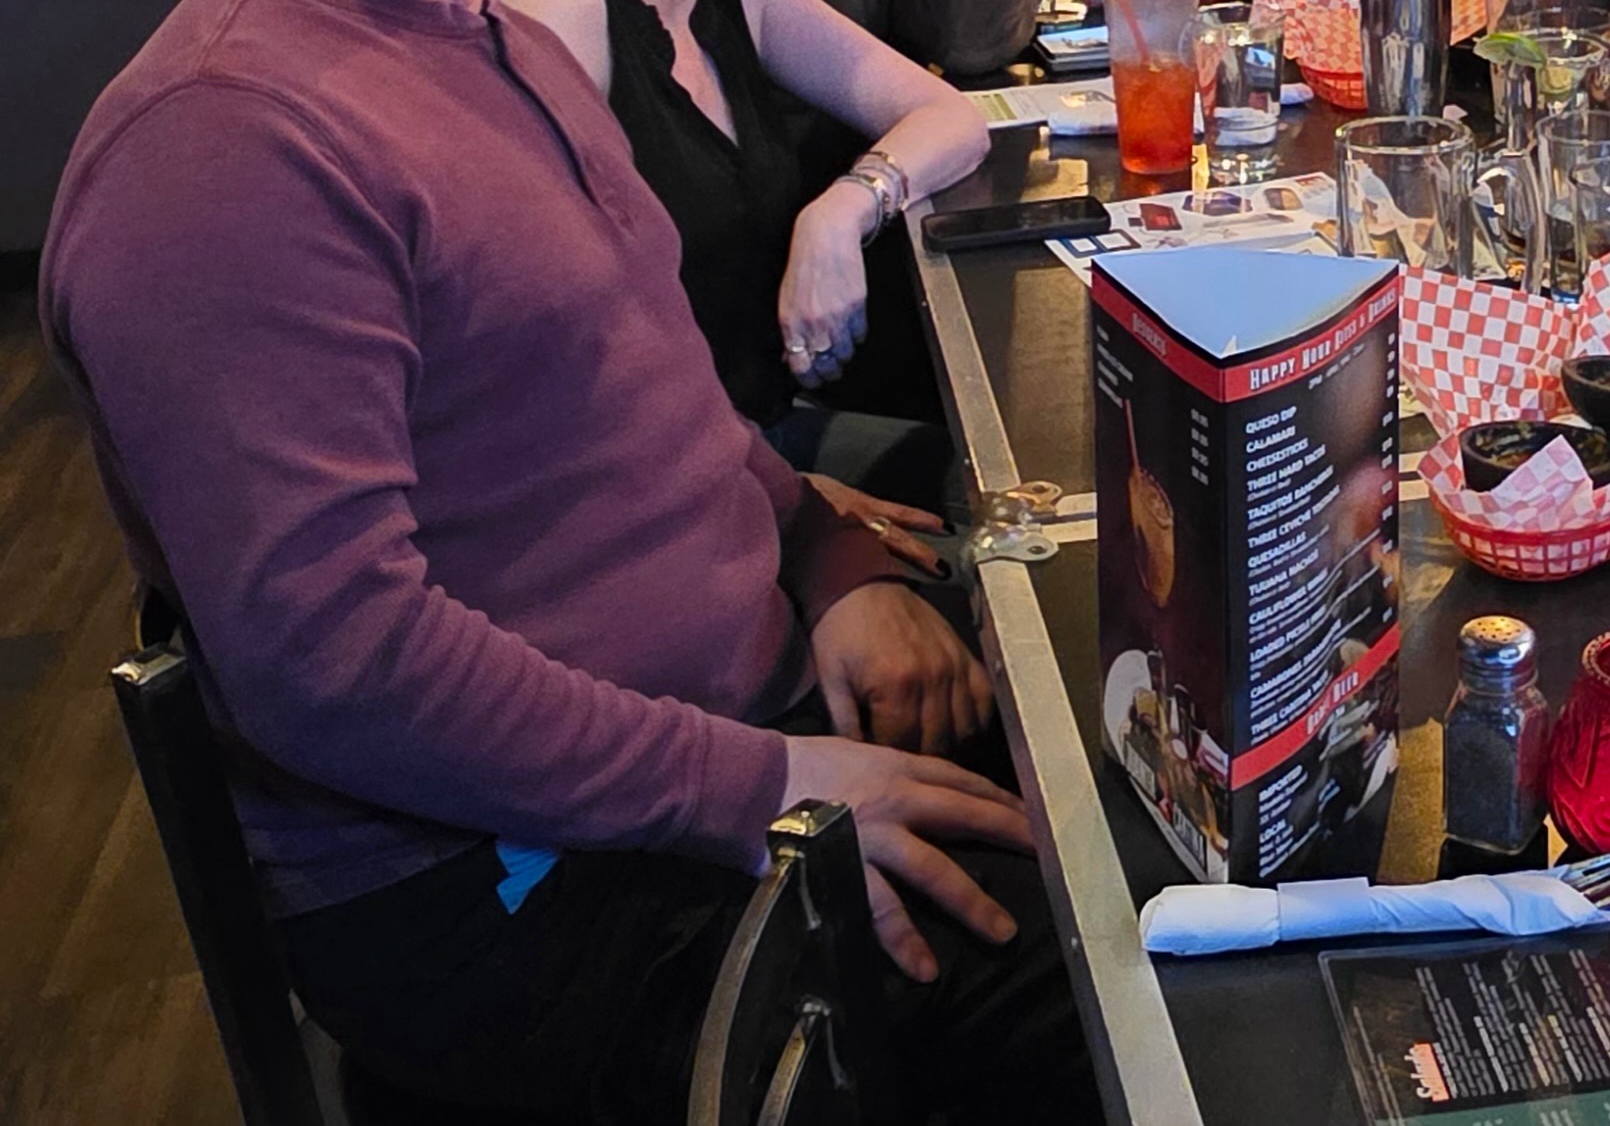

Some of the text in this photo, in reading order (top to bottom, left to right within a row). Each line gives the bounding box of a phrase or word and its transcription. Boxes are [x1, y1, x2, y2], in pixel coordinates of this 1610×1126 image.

[1250, 357, 1295, 390] HAPPY
[1302, 340, 1330, 370] HOUR
[1246, 406, 1297, 433] QUESO DIP
[1246, 426, 1296, 453] CALAMARI
[1247, 492, 1293, 520] TAQUITOS
[1250, 636, 1285, 662] LOADED
[1260, 818, 1286, 844] LOCAL
[1404, 1046, 1442, 1101] Salads
